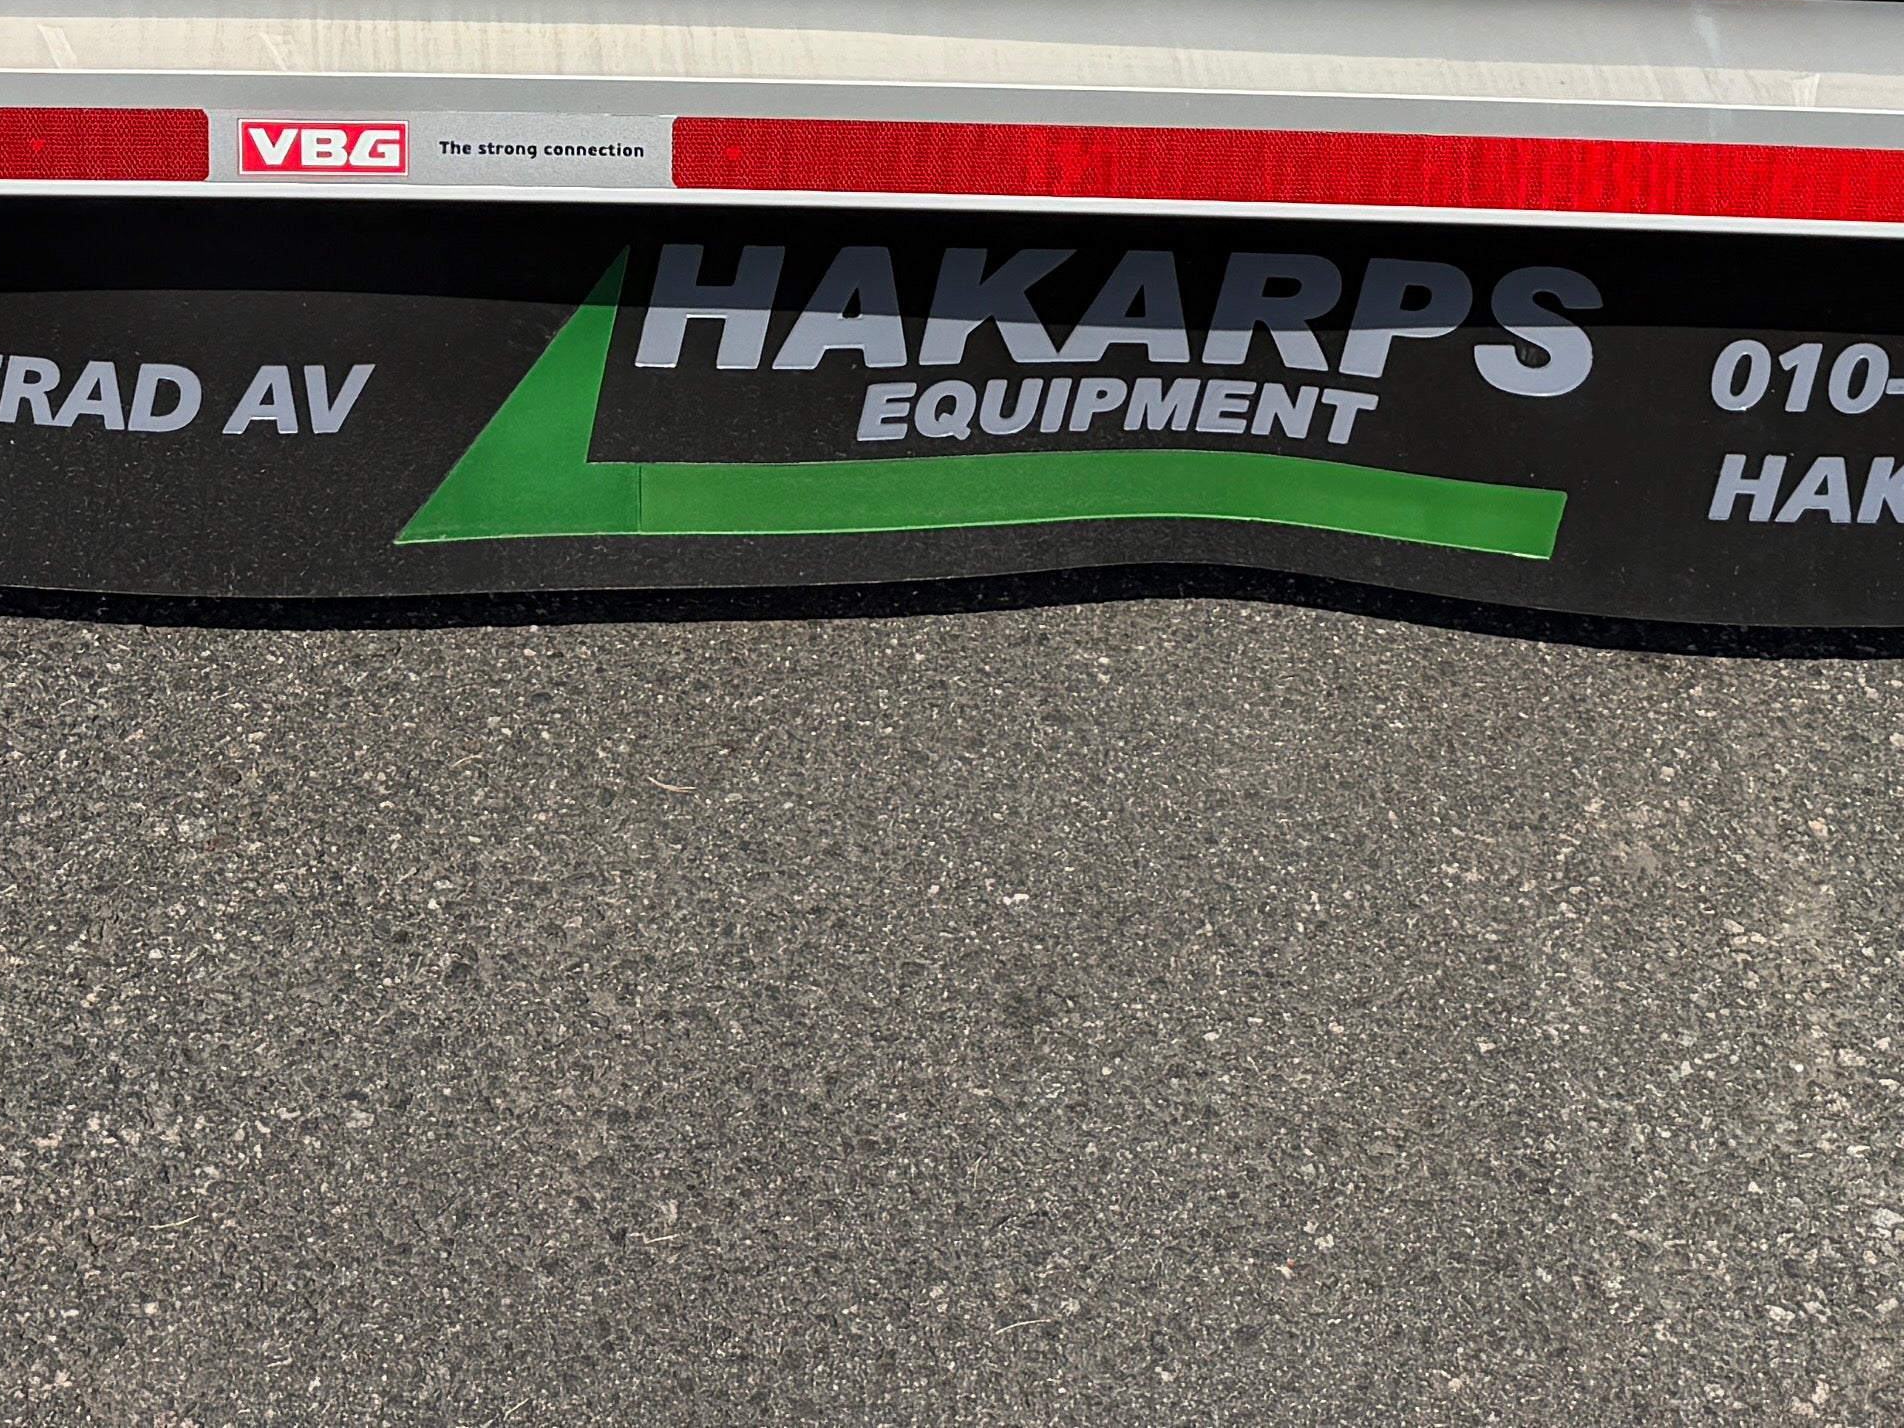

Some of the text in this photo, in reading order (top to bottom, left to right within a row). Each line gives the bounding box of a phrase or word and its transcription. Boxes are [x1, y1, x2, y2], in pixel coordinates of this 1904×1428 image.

[247, 126, 402, 168] VBG
[438, 140, 645, 160] The strong connection
[633, 243, 1604, 398] HAKARPS
[222, 363, 376, 435] AV
[856, 377, 1380, 445] EQUIPMENT
